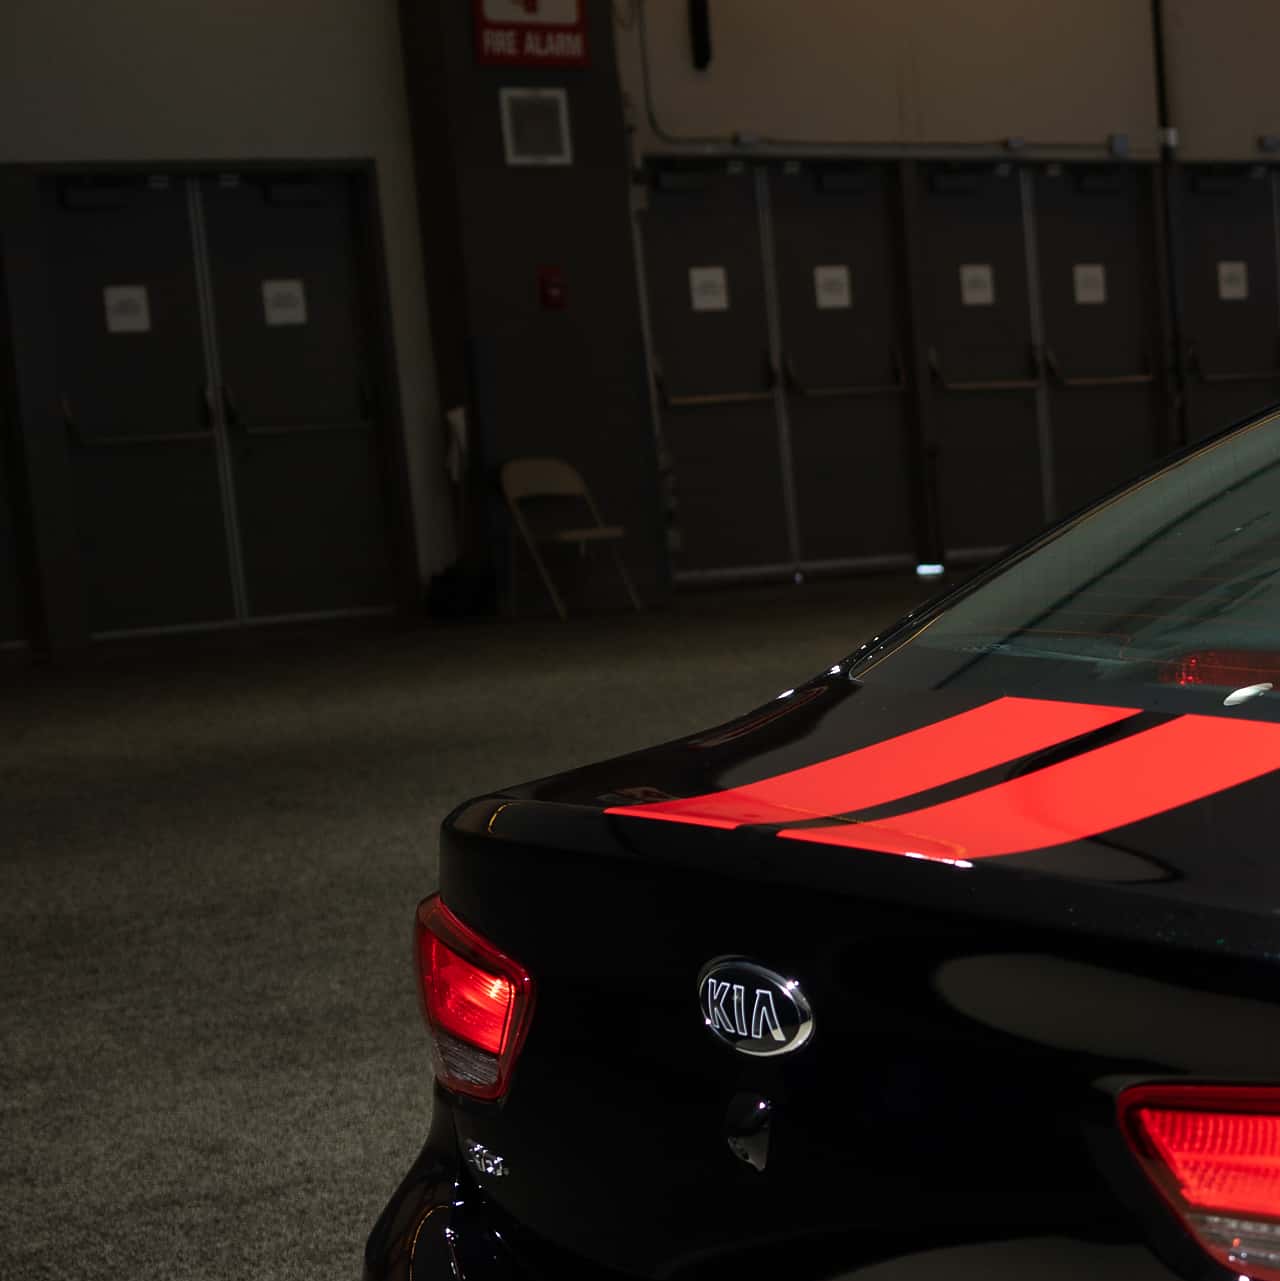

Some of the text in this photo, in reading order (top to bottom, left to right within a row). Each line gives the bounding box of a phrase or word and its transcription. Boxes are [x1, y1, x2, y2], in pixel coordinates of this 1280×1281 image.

[482, 28, 583, 58] FIRE ALARM
[707, 977, 786, 1042] KIA
